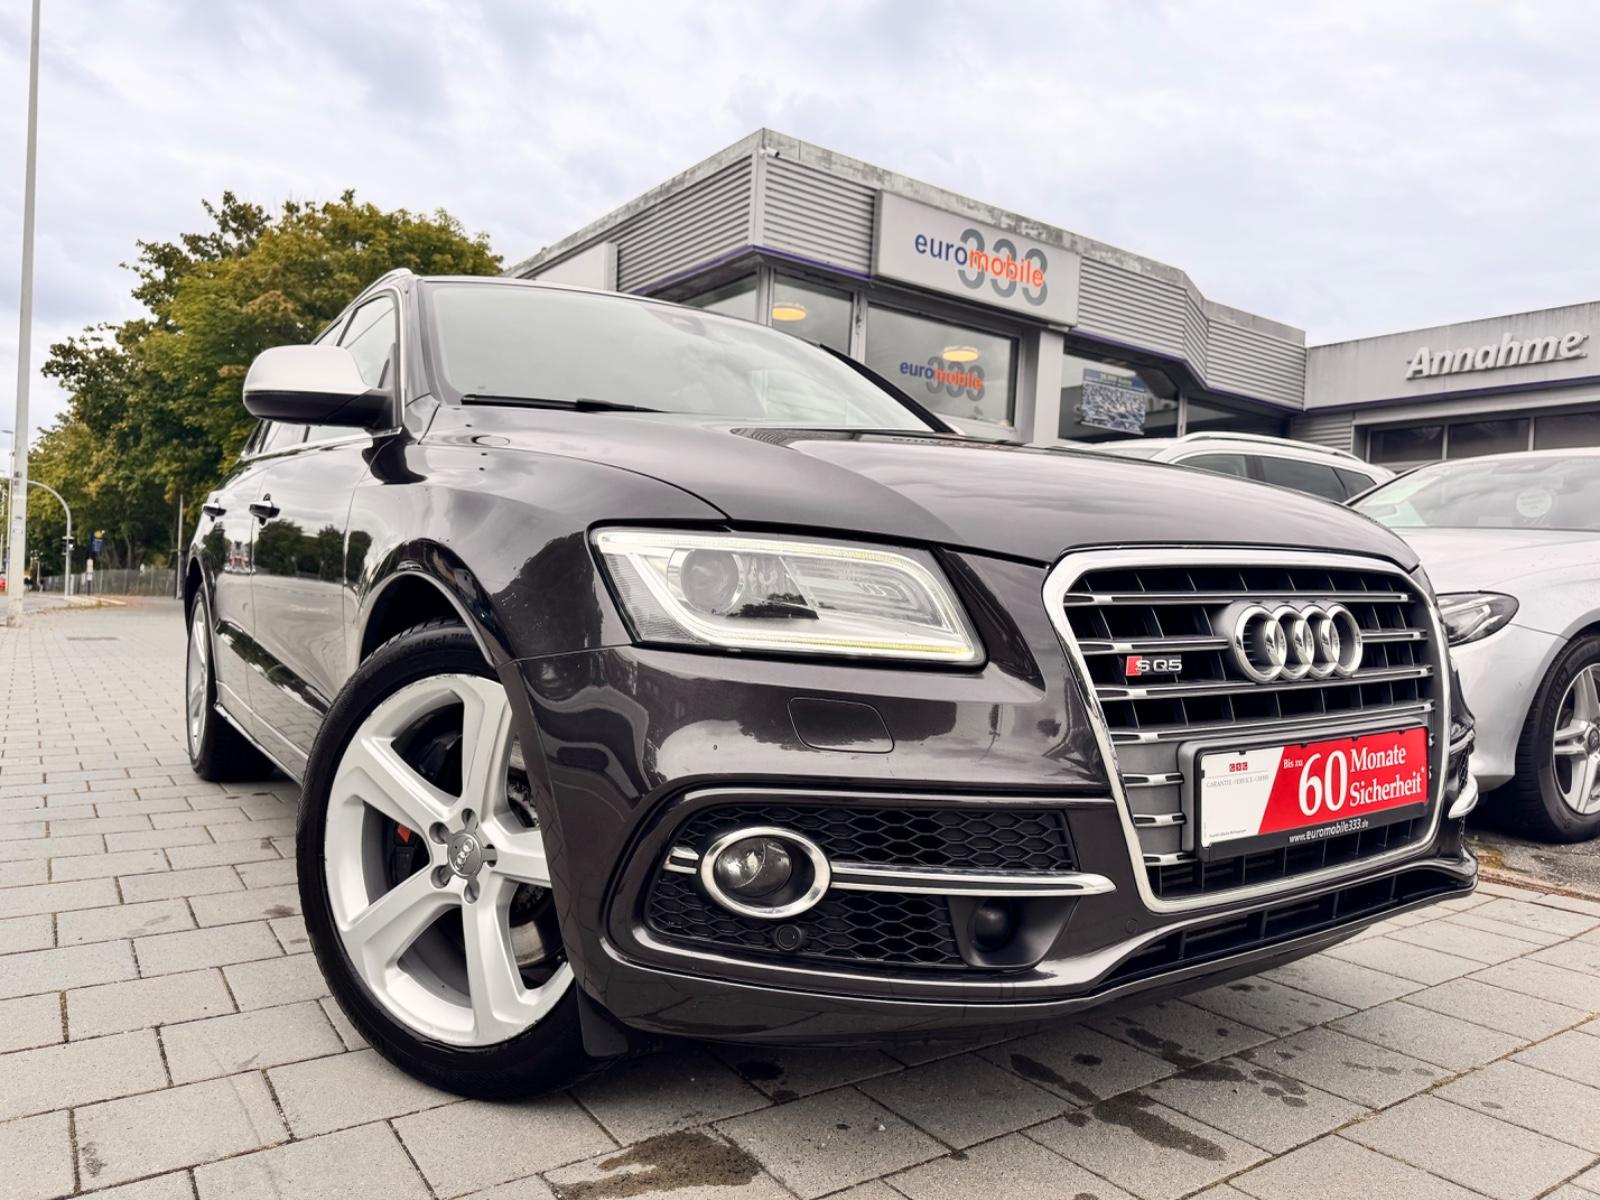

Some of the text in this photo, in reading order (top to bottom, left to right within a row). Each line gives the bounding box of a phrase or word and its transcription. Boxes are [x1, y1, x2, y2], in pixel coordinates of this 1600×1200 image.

[915, 234, 1044, 288] euromobile
[958, 228, 1048, 306] 333
[899, 361, 984, 391] euromobile
[1406, 331, 1587, 380] Annahme
[1350, 744, 1407, 772] Monate
[1283, 759, 1294, 769] Bis
[1299, 750, 1348, 816] 60
[1289, 818, 1369, 843] www.euromobile333.de
